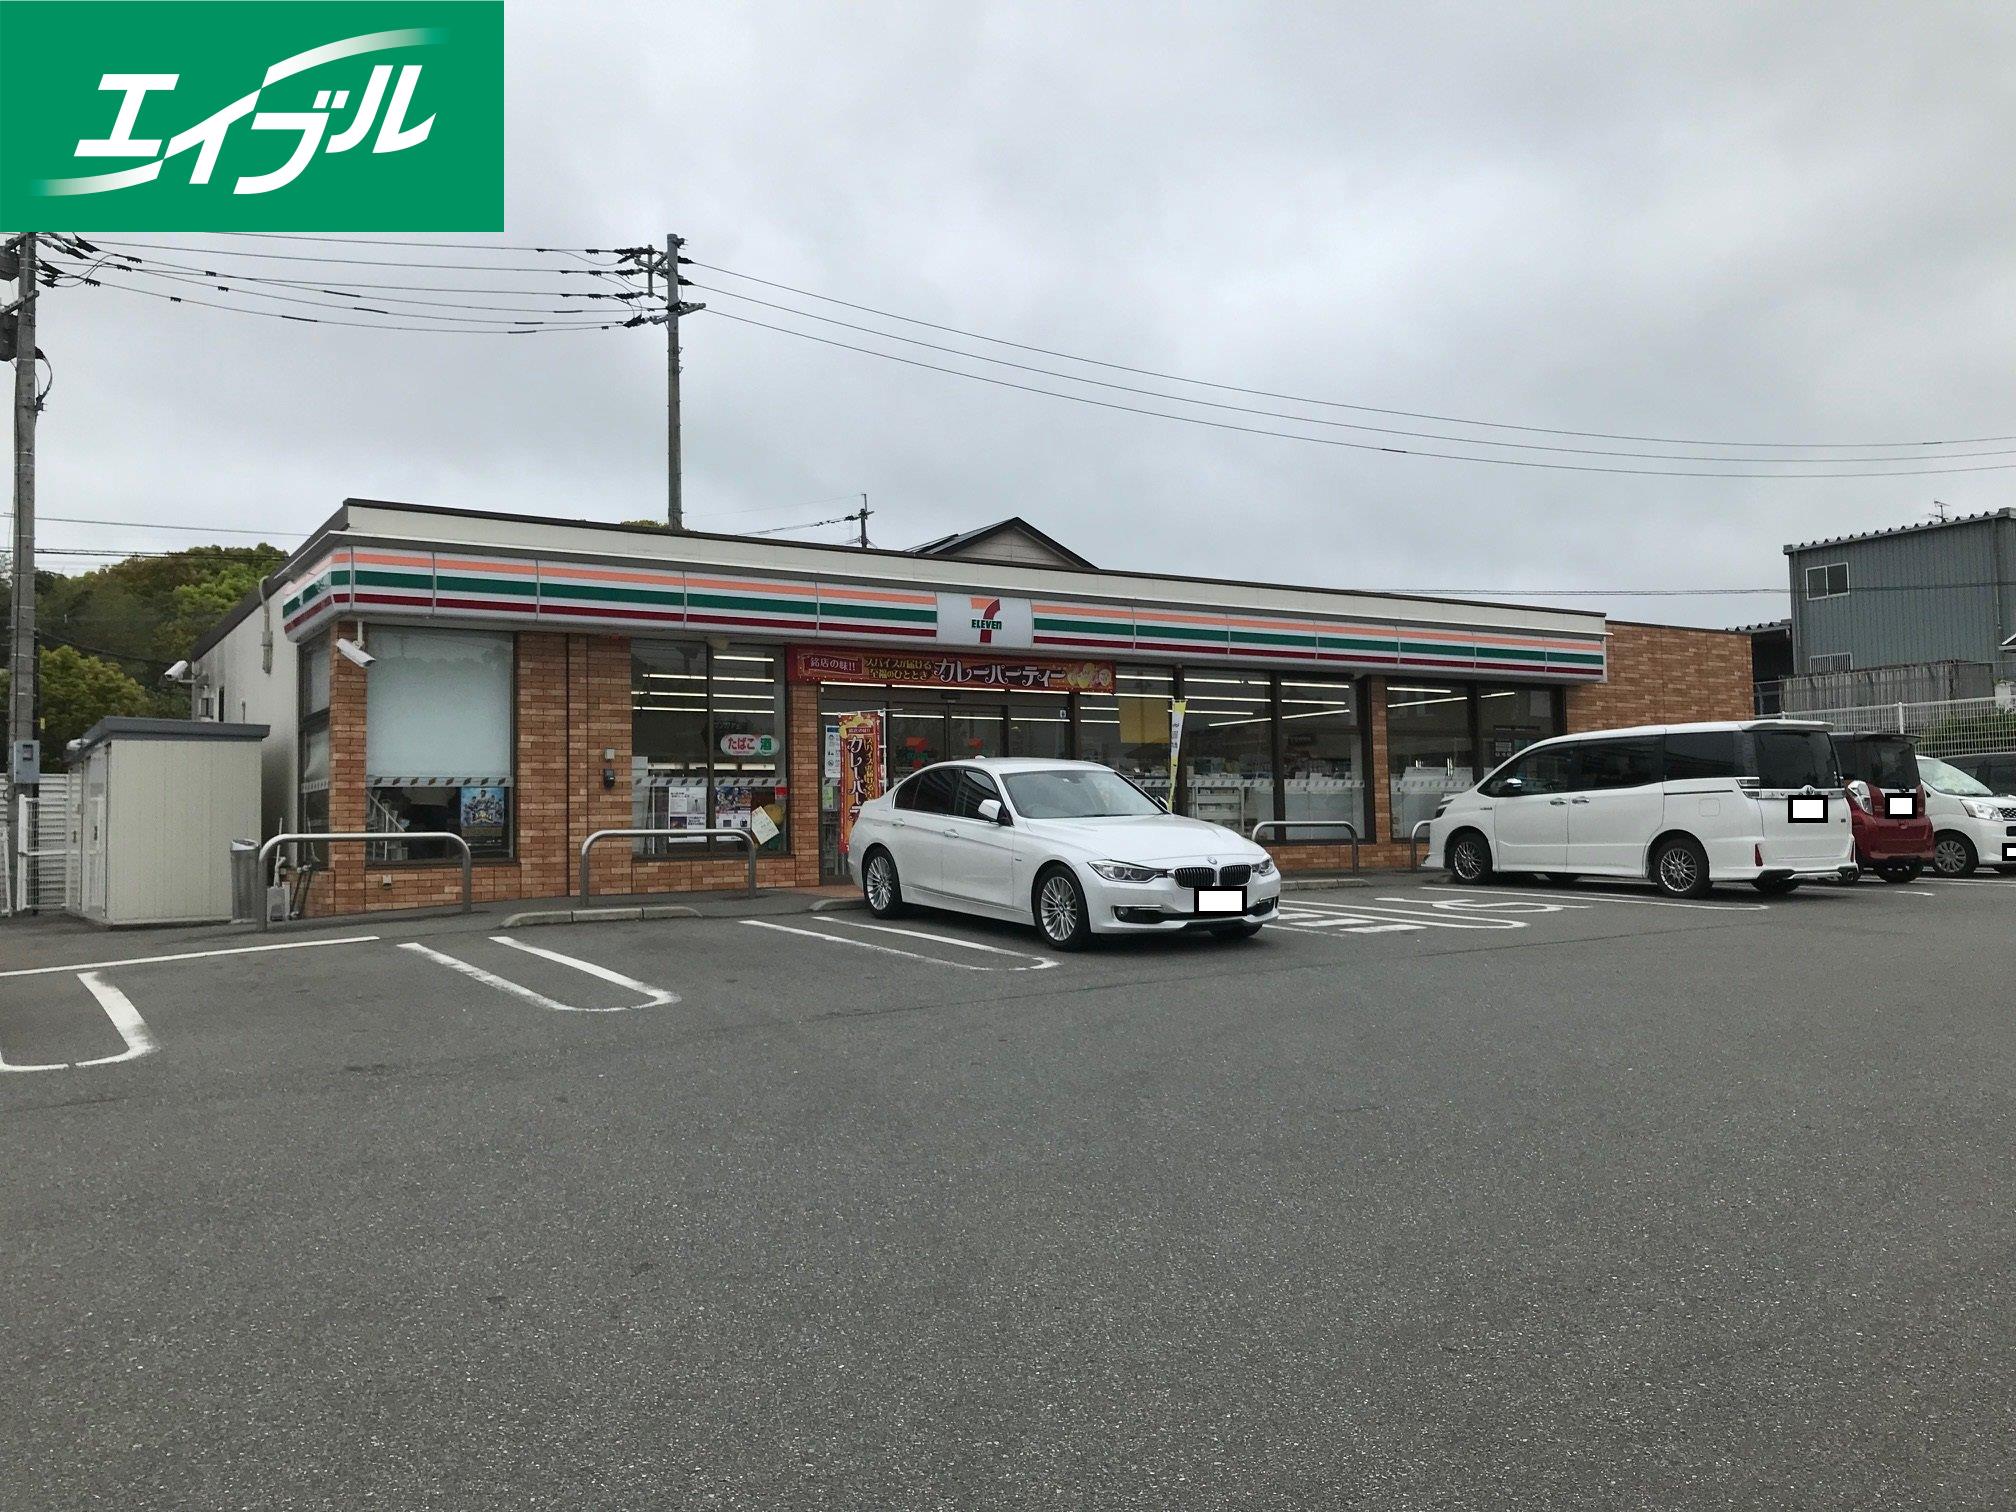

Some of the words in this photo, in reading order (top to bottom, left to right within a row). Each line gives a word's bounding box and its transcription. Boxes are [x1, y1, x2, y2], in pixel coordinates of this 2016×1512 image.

[933, 658, 1066, 687] カレーパーティー
[728, 737, 755, 750] たばこ
[760, 737, 772, 750] 酒
